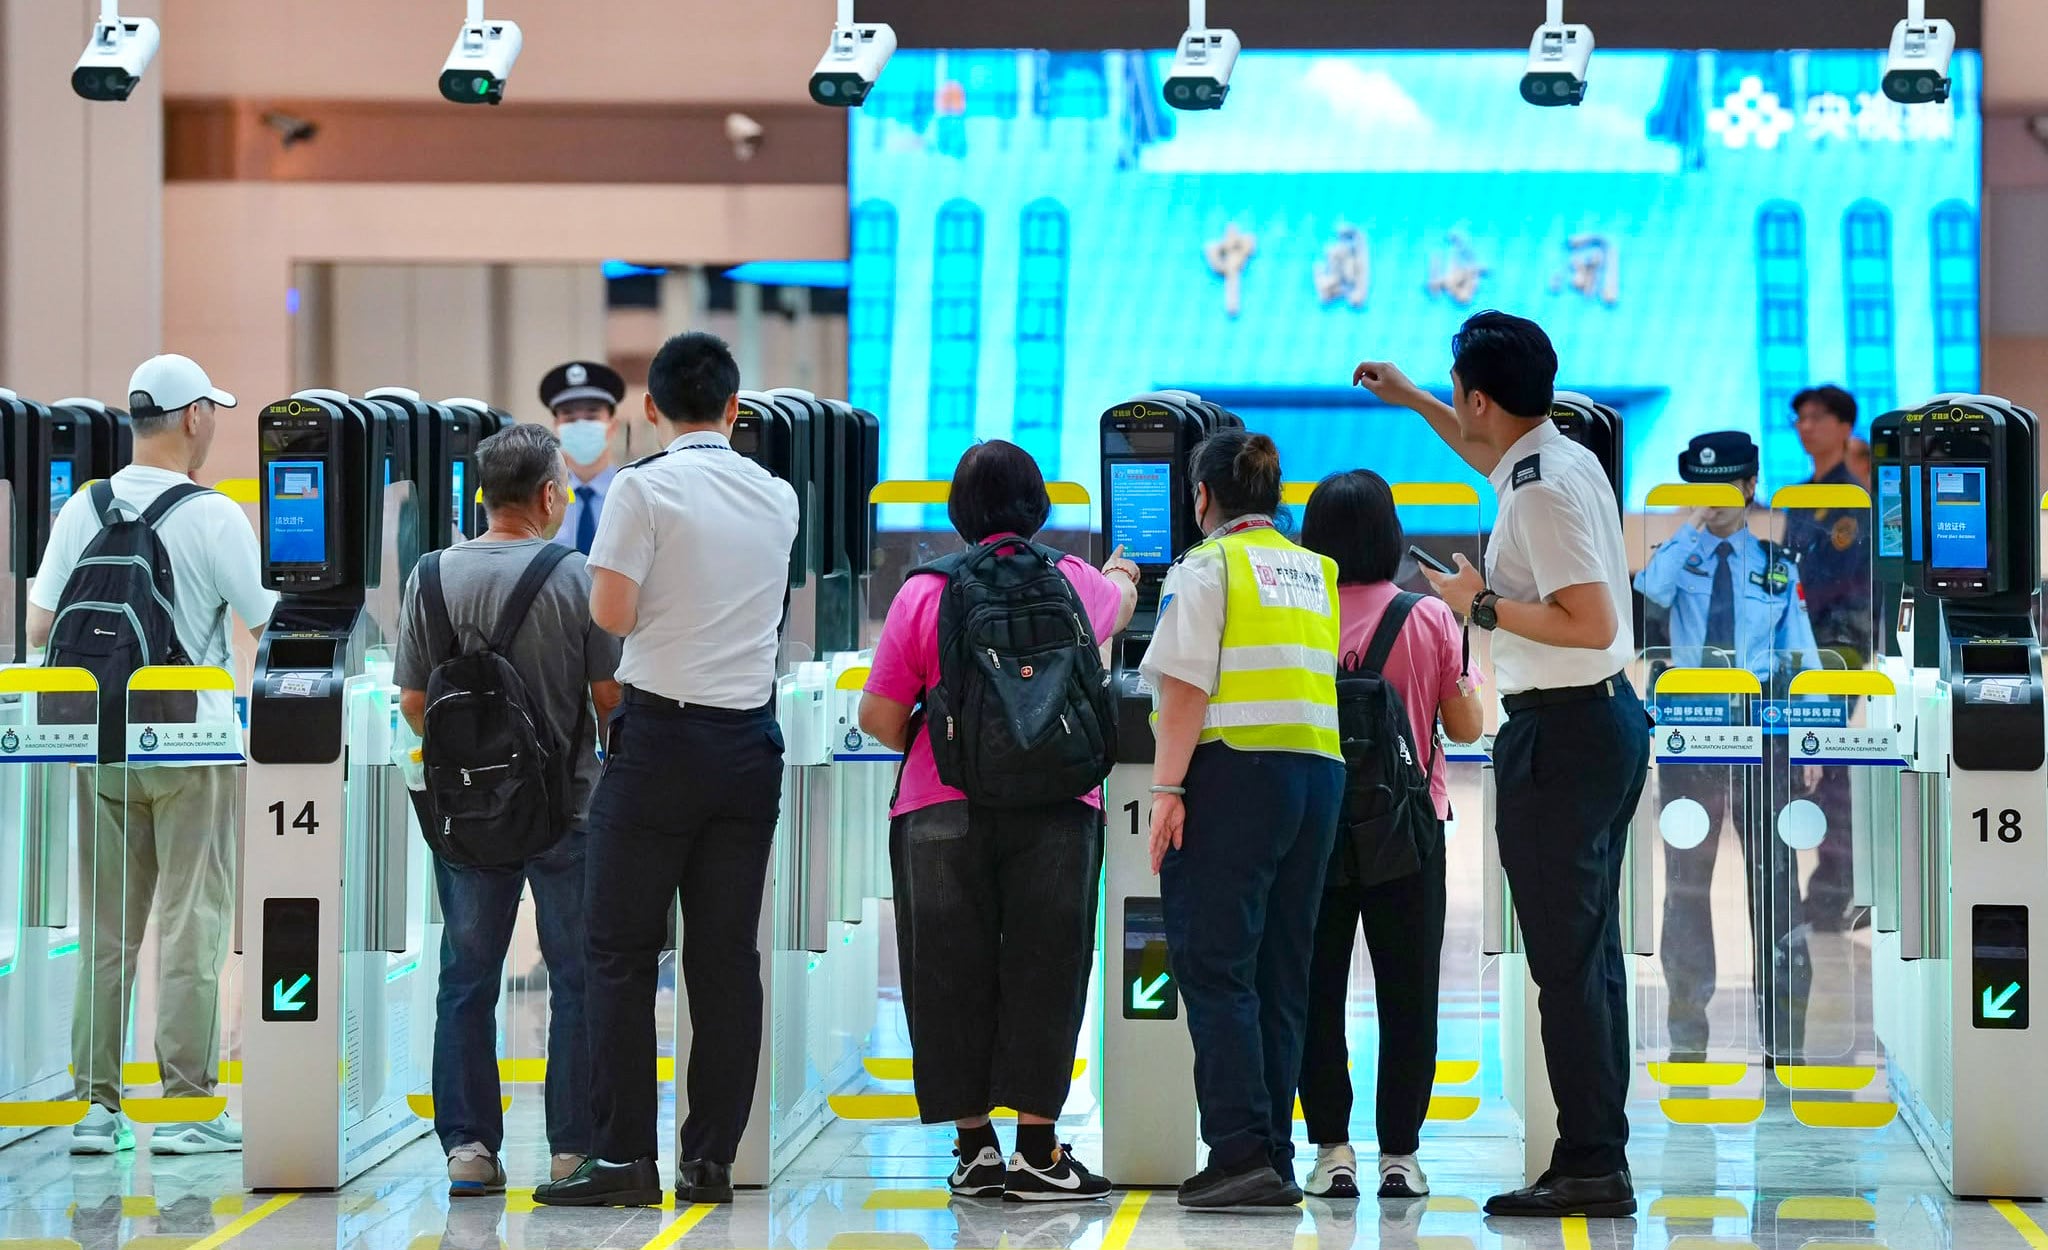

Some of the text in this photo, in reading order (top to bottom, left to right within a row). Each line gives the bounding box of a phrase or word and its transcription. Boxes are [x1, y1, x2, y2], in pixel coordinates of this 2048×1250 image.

[1663, 707, 1724, 716] 中国移民管理
[1782, 708, 1842, 717] 中国移民管理
[25, 733, 90, 741] 入境事務處
[163, 732, 227, 740] 入境事務處
[268, 800, 320, 836] 14
[1123, 800, 1152, 835] 1
[1972, 807, 2023, 844] 18
